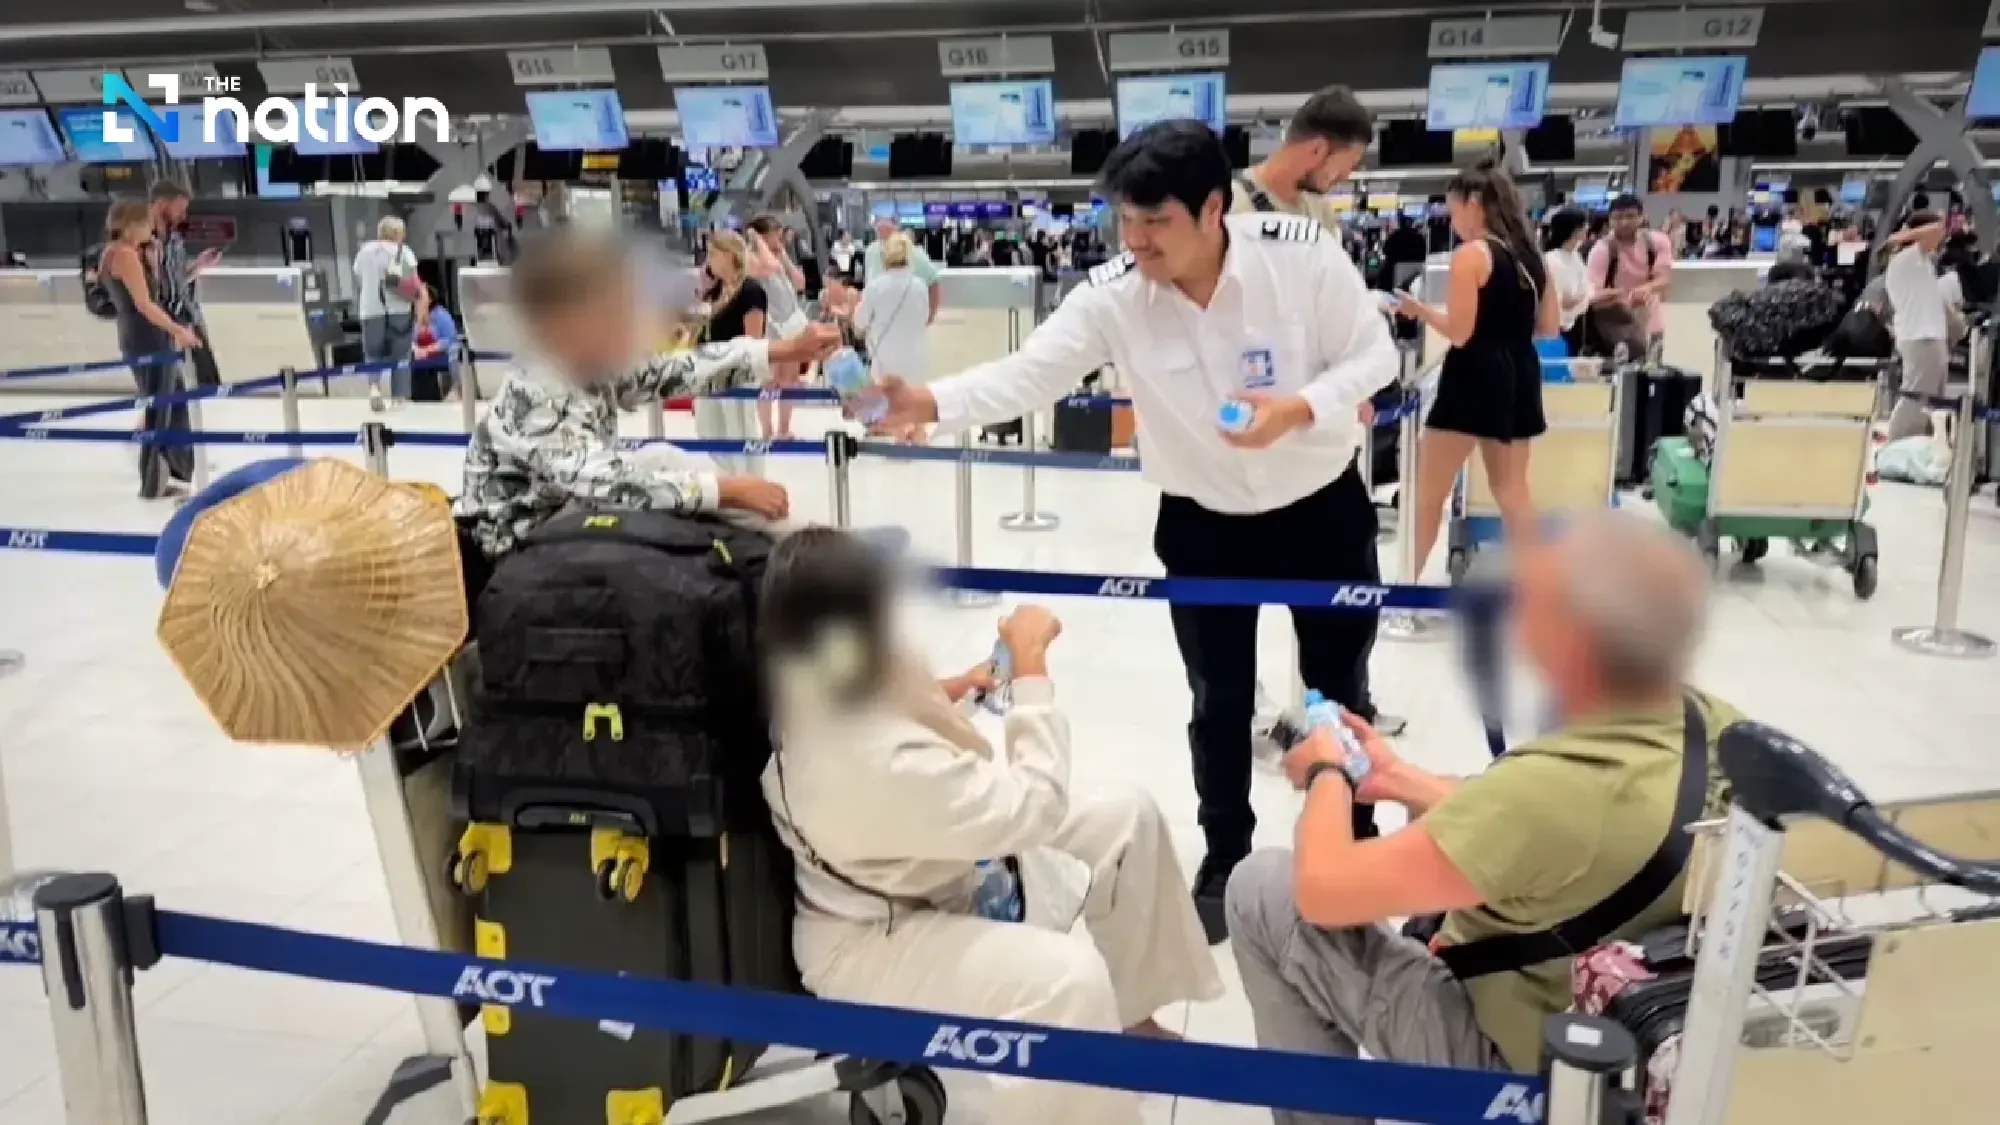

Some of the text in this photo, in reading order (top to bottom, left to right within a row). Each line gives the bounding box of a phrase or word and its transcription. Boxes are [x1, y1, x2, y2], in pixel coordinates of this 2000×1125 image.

[1438, 28, 1484, 46] G14
[1704, 17, 1752, 37] G12
[1178, 38, 1219, 57] G15
[722, 52, 756, 70] G17
[1097, 577, 1152, 597] AOT
[1330, 585, 1389, 607] AOT
[453, 965, 556, 1007] AOT
[924, 1025, 1047, 1069] AOT
